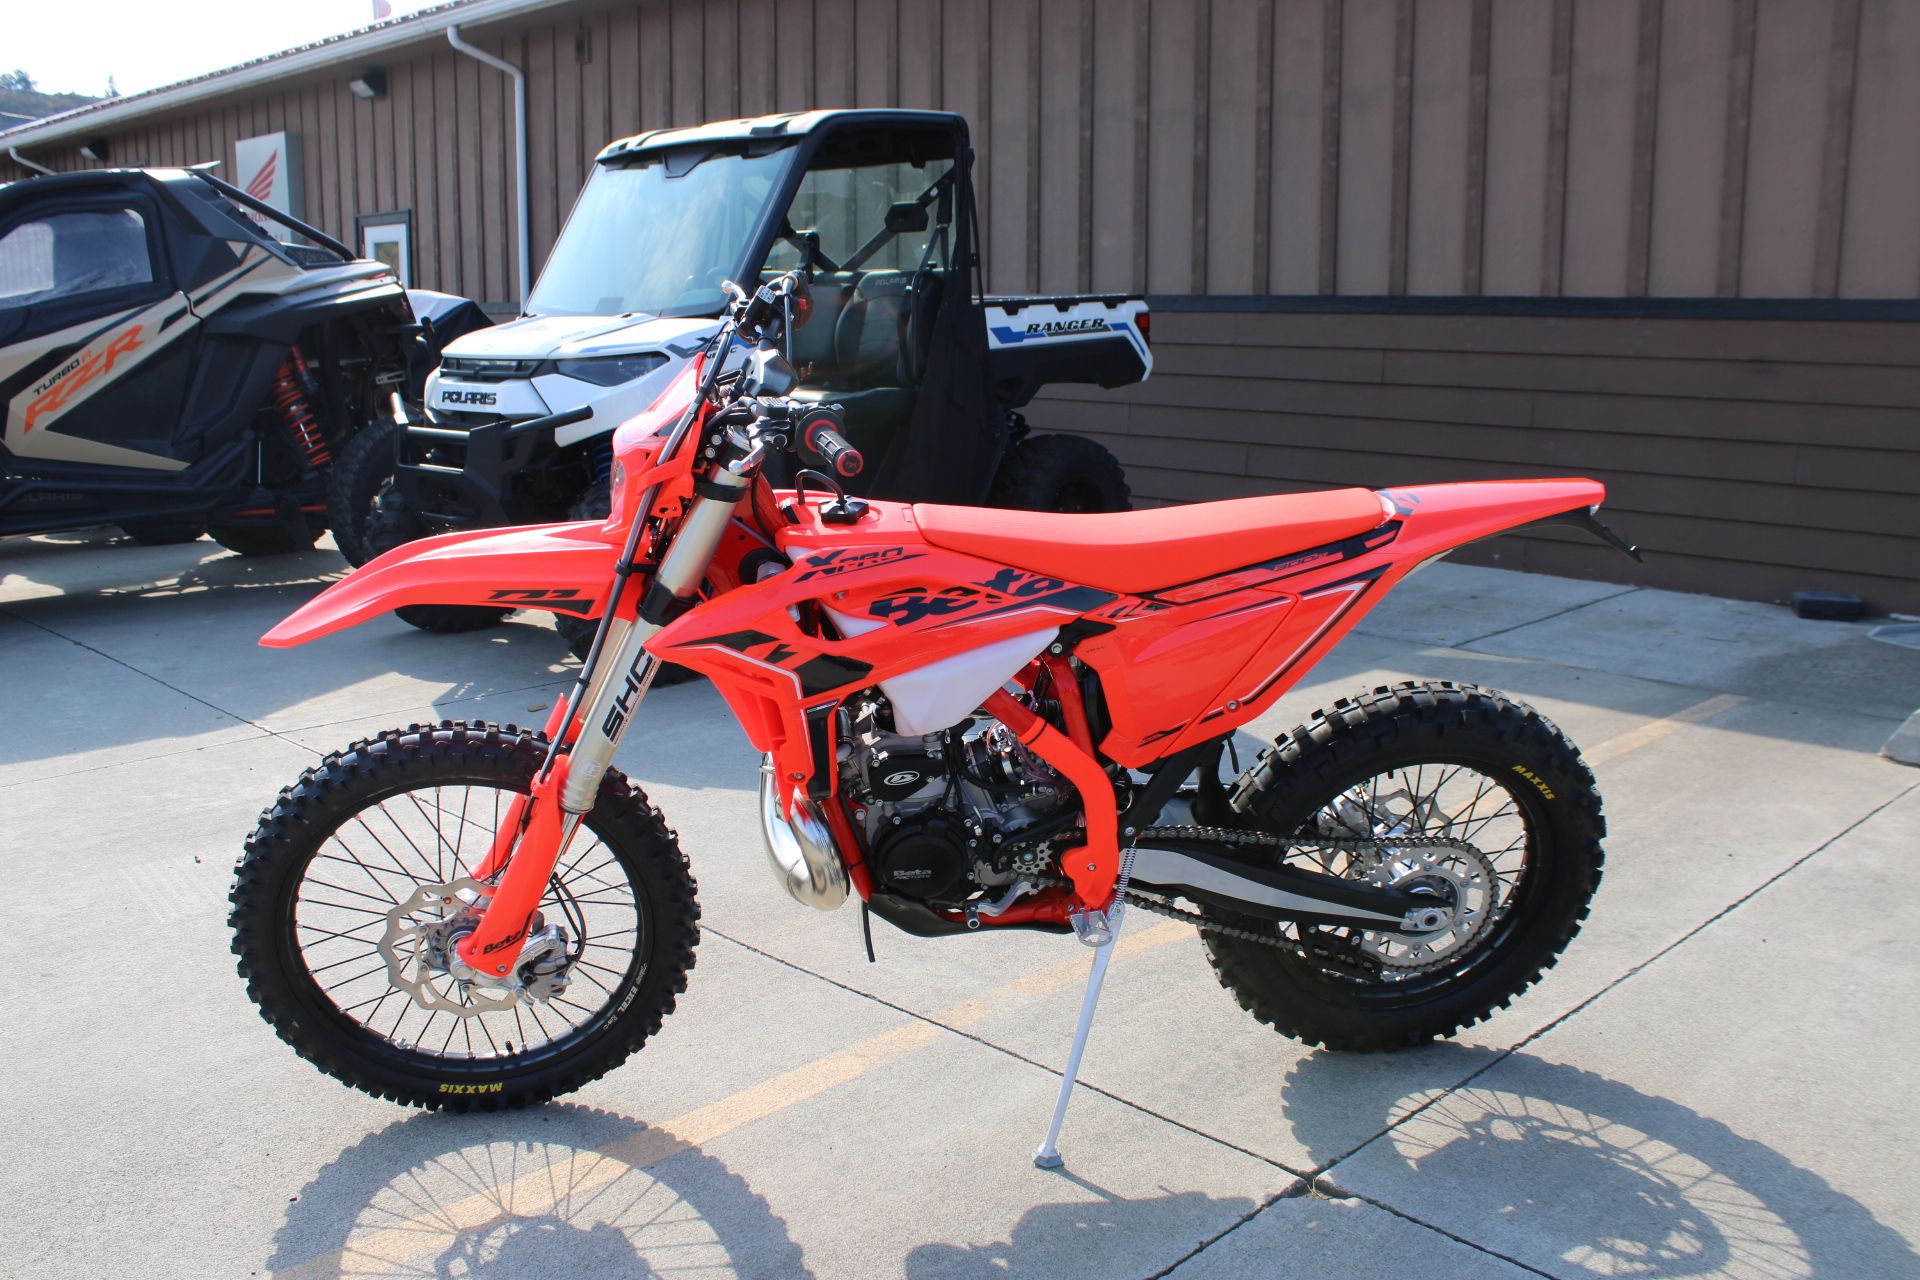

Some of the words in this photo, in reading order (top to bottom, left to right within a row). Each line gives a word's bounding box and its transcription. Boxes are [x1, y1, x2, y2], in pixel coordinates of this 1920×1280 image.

[1025, 318, 1105, 335] RANGER
[24, 324, 145, 434] RZR
[33, 358, 80, 396] TURBO
[442, 391, 497, 406] POLARIS
[1512, 765, 1555, 799] MAXXIS
[893, 869, 932, 877] Beta
[483, 929, 522, 955] Beta
[617, 985, 639, 1012] EXCEL
[438, 1082, 503, 1094] MAXXIS
